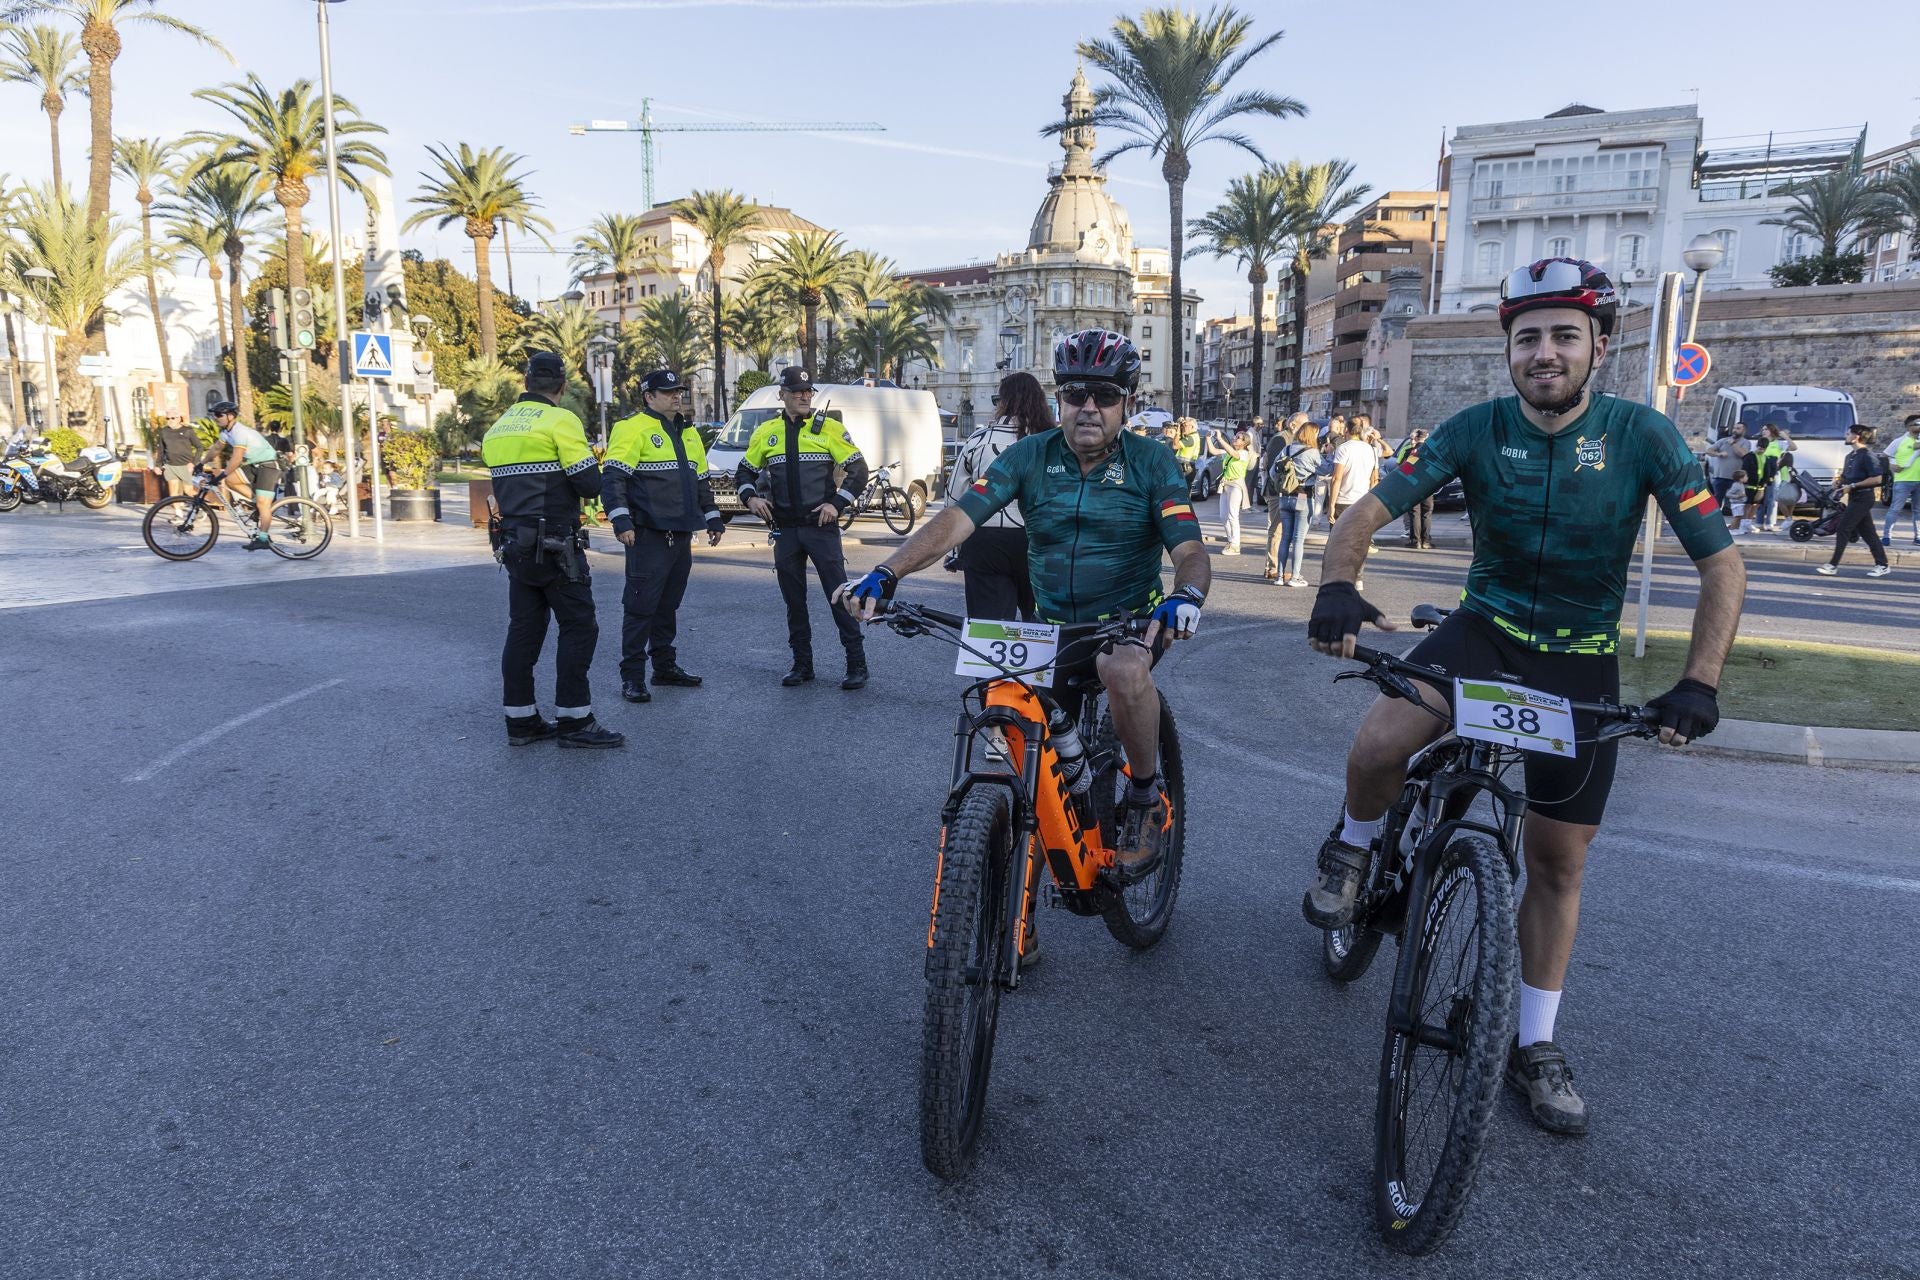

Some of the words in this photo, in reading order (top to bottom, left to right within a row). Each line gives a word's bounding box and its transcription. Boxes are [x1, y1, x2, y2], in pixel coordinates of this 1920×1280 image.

[1501, 446, 1528, 460] GOBIK
[1581, 451, 1600, 461] 062
[1106, 468, 1121, 479] 062
[988, 641, 1028, 667] 39
[1492, 704, 1540, 735] 38
[1421, 866, 1476, 951] BONTRAGE
